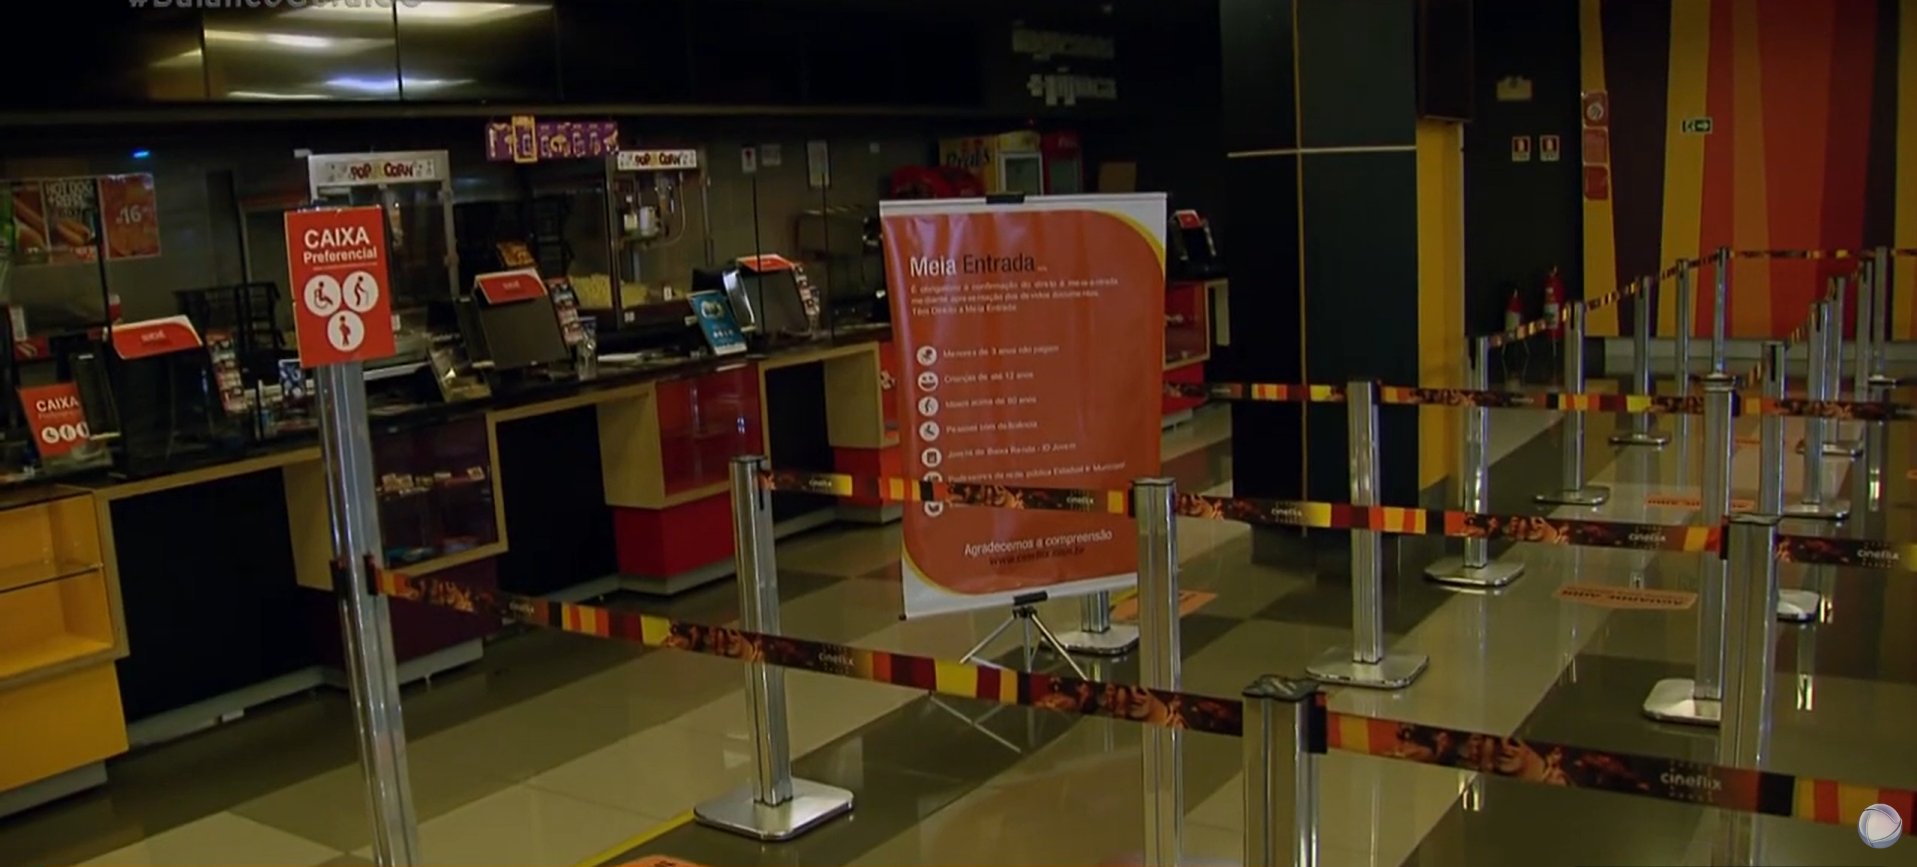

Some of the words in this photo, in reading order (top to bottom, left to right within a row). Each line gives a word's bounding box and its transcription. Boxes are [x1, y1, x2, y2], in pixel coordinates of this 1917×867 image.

[304, 226, 370, 249] CAIXA
[303, 246, 377, 264] Preferencial
[910, 255, 957, 277] Meia
[963, 253, 1034, 274] Entrada
[36, 395, 79, 412] CAIXA
[964, 538, 1034, 557] Agradecemos
[1036, 538, 1043, 548] a
[1045, 529, 1113, 549] compreensão
[1660, 771, 1721, 791] cineflix
